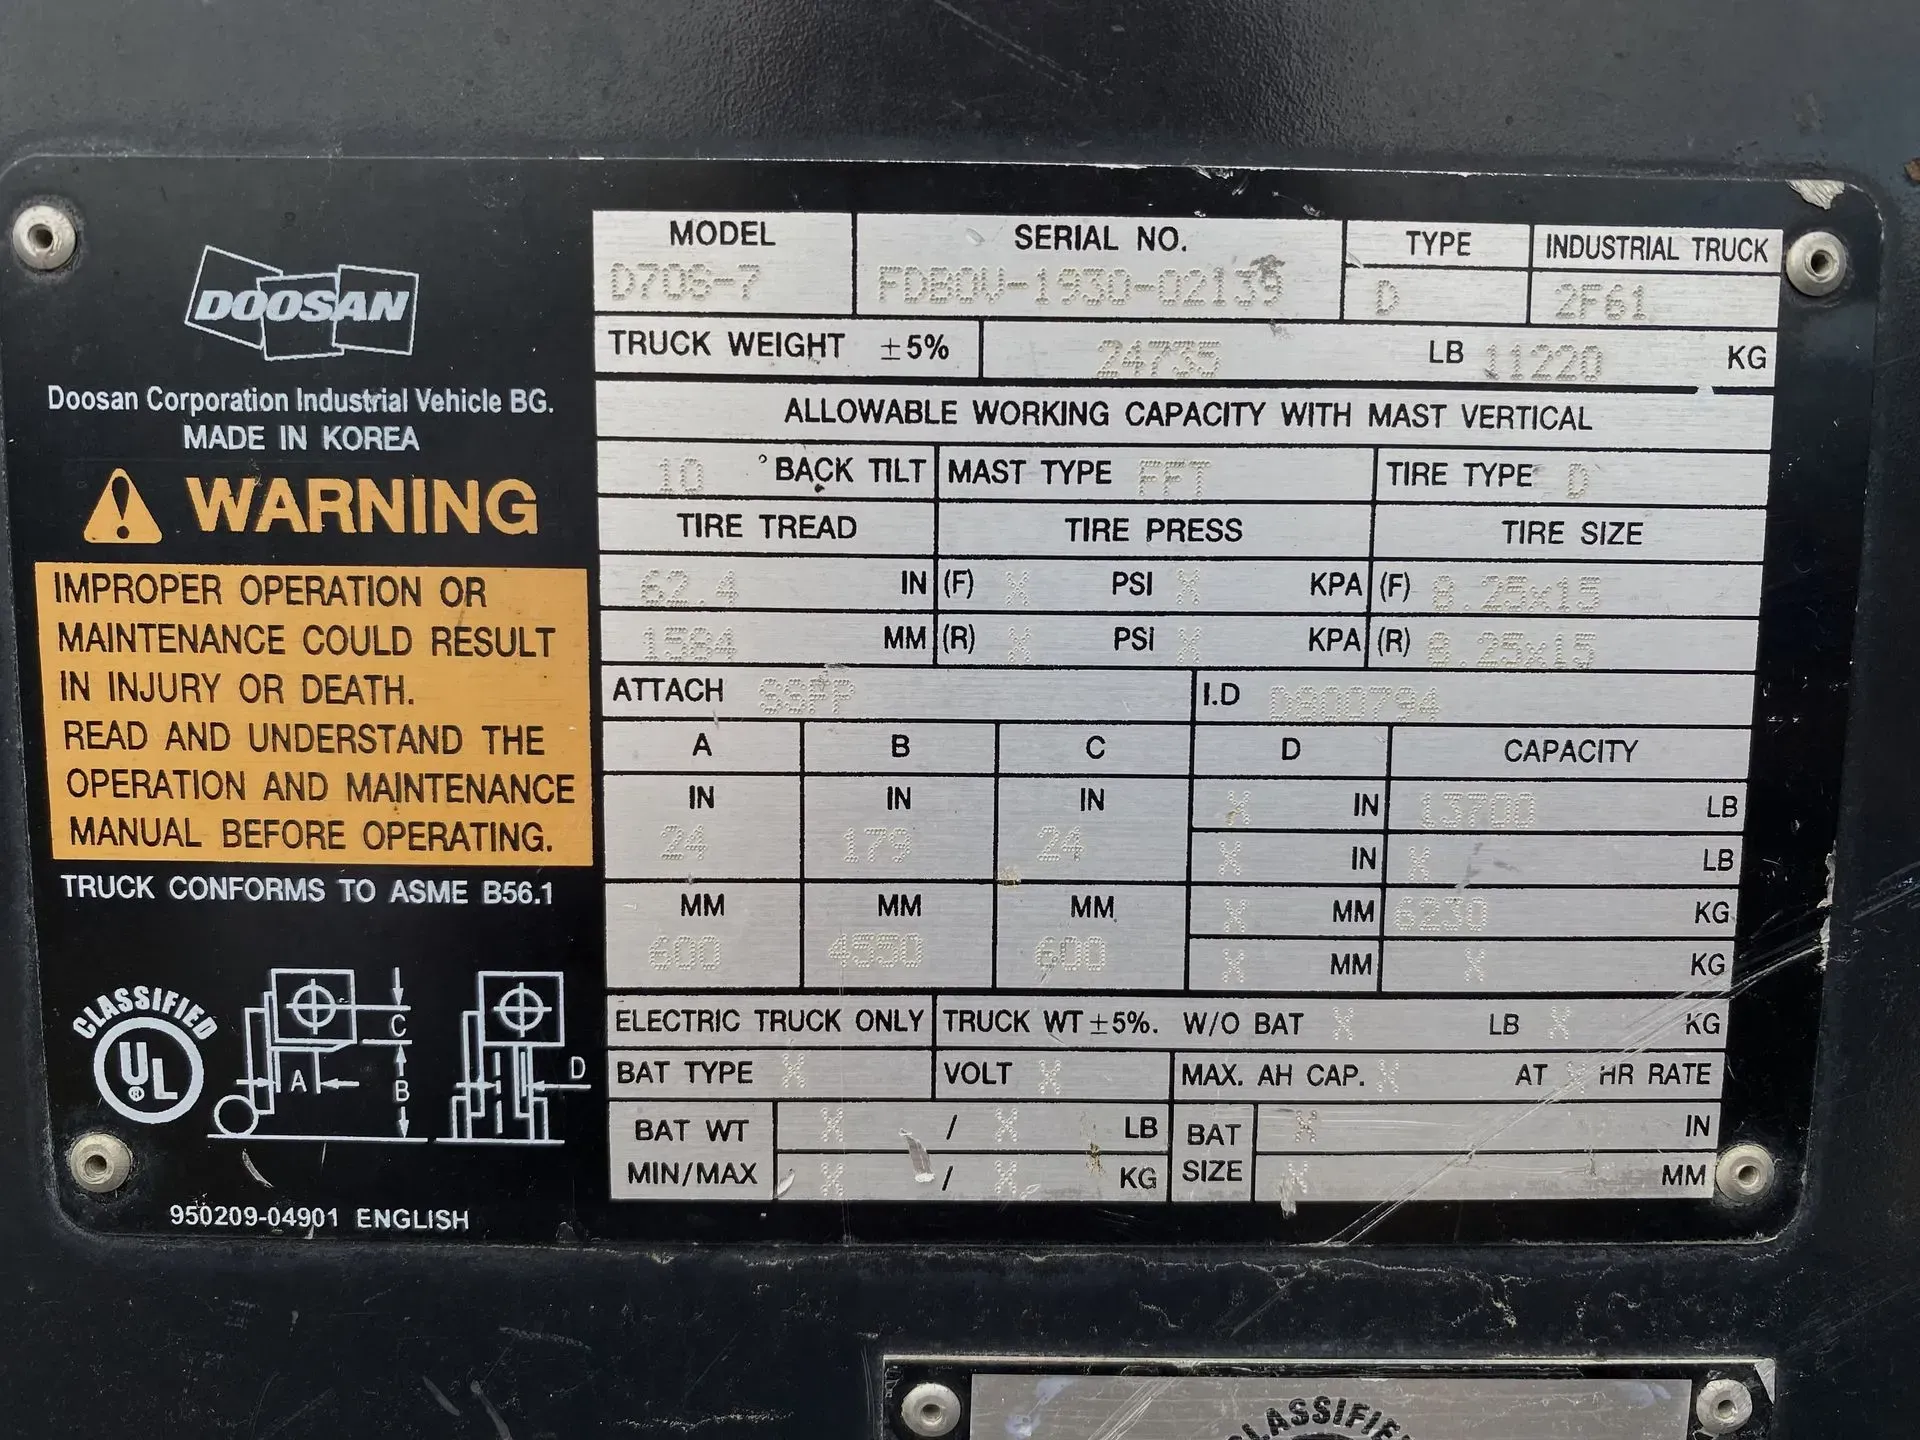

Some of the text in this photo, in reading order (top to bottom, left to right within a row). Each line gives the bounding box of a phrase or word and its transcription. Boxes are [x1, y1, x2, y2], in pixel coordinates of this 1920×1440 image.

[670, 220, 776, 246] MODEL
[1015, 224, 1186, 251] SERIAL NO.
[1406, 231, 1471, 256] TYPE
[1547, 234, 1768, 262] INDUSTRIAL TRUCK
[611, 263, 761, 300] D70S-7
[195, 290, 410, 321] DOOSAN
[1555, 283, 1647, 321] 2F61
[608, 330, 711, 356] TRUCK
[728, 332, 845, 359] WEIGHT
[1097, 338, 1766, 381] 24735 LB 11220 KG
[48, 385, 553, 417] Doosan Corporation Industrial Vehicle BG.
[784, 398, 1592, 430] ALLOWABLE WORKING CAPACITY WITH MAST VERTICAL
[184, 425, 419, 451] MADE IN KOREA
[658, 457, 705, 494] 10
[868, 458, 926, 483] TILT
[949, 459, 1211, 496] MAST TYPE FFT
[1386, 461, 1533, 487] TIRE TYPE
[186, 478, 537, 534] WARNING
[677, 513, 856, 539] TIRE TREAD
[1065, 517, 1242, 542] TIRE PRESS
[1502, 520, 1643, 545] TIRE SIZE
[55, 572, 486, 607] IMPROPER OPERATION OR
[640, 569, 926, 607] 62.4 IN
[943, 568, 1362, 598] (F) PSI KPA
[1380, 572, 1410, 602] (F)
[58, 622, 555, 657] MAINTENANCE COULD RESULT
[642, 626, 926, 662] 1584 MM
[942, 624, 1361, 653] (R) PSI KPA
[1377, 628, 1410, 657] (R)
[61, 671, 413, 705] IN INJURY OR DEATH.
[613, 677, 723, 702] ATTACH
[1204, 682, 1240, 705] I.D
[64, 720, 544, 755] READ AND UNDERSTAND THE
[693, 733, 712, 756] A
[892, 734, 910, 757] B
[1086, 736, 1105, 759] C
[1282, 738, 1300, 760] D
[1505, 739, 1638, 763] CAPACITY
[67, 768, 574, 804] OPERATION AND MAINTENANCE
[690, 785, 714, 809] IN
[888, 786, 910, 810] IN
[1081, 788, 1104, 811] IN
[1354, 793, 1378, 816] IN
[1420, 792, 1737, 829] 13700 LB
[70, 816, 552, 852] MANUAL BEFORE OPERATING.
[659, 824, 708, 861] 24
[842, 827, 912, 864] 179
[1036, 826, 1085, 863] 24
[1352, 847, 1376, 870] IN
[1704, 849, 1733, 871] LB
[61, 875, 551, 904] TRUCK CONFORMS TO ASME B56.1
[681, 894, 724, 916] MM
[879, 894, 921, 916] MM
[1071, 895, 1114, 918] MM
[1333, 900, 1374, 922] MM
[1393, 897, 1729, 932] 6230 KG
[648, 935, 721, 971] 600
[827, 933, 924, 970] 4550
[1034, 935, 1106, 972] 600
[1331, 953, 1371, 975] MM
[1691, 953, 1725, 976] KG
[72, 985, 218, 1040] CLASSIFIED
[616, 1009, 924, 1032] ELECTRIC TRUCK ONLY
[943, 1009, 1030, 1032] TRUCK
[1043, 1010, 1083, 1033] WT
[1183, 1012, 1239, 1036] W/O
[1255, 1012, 1304, 1035] BAT
[1490, 1014, 1519, 1035] LB
[391, 1014, 406, 1037] C
[571, 1057, 585, 1078] D
[617, 1061, 753, 1084] BAT TYPE
[944, 1062, 1012, 1084] VOLT
[1183, 1063, 1711, 1086] MAX. AH CAP. AT RATE
[291, 1070, 307, 1092] A
[395, 1080, 409, 1101] B
[635, 1119, 749, 1142] BAT WT
[1125, 1117, 1157, 1138] LB
[1188, 1124, 1241, 1145] BAT
[1686, 1115, 1710, 1137] IN
[628, 1162, 757, 1186] MIN/MAX
[1121, 1167, 1156, 1189] KG
[1183, 1160, 1242, 1182] SIZE
[1662, 1165, 1706, 1185] MM
[170, 1205, 468, 1229] 950209-04901 ENGLISH
